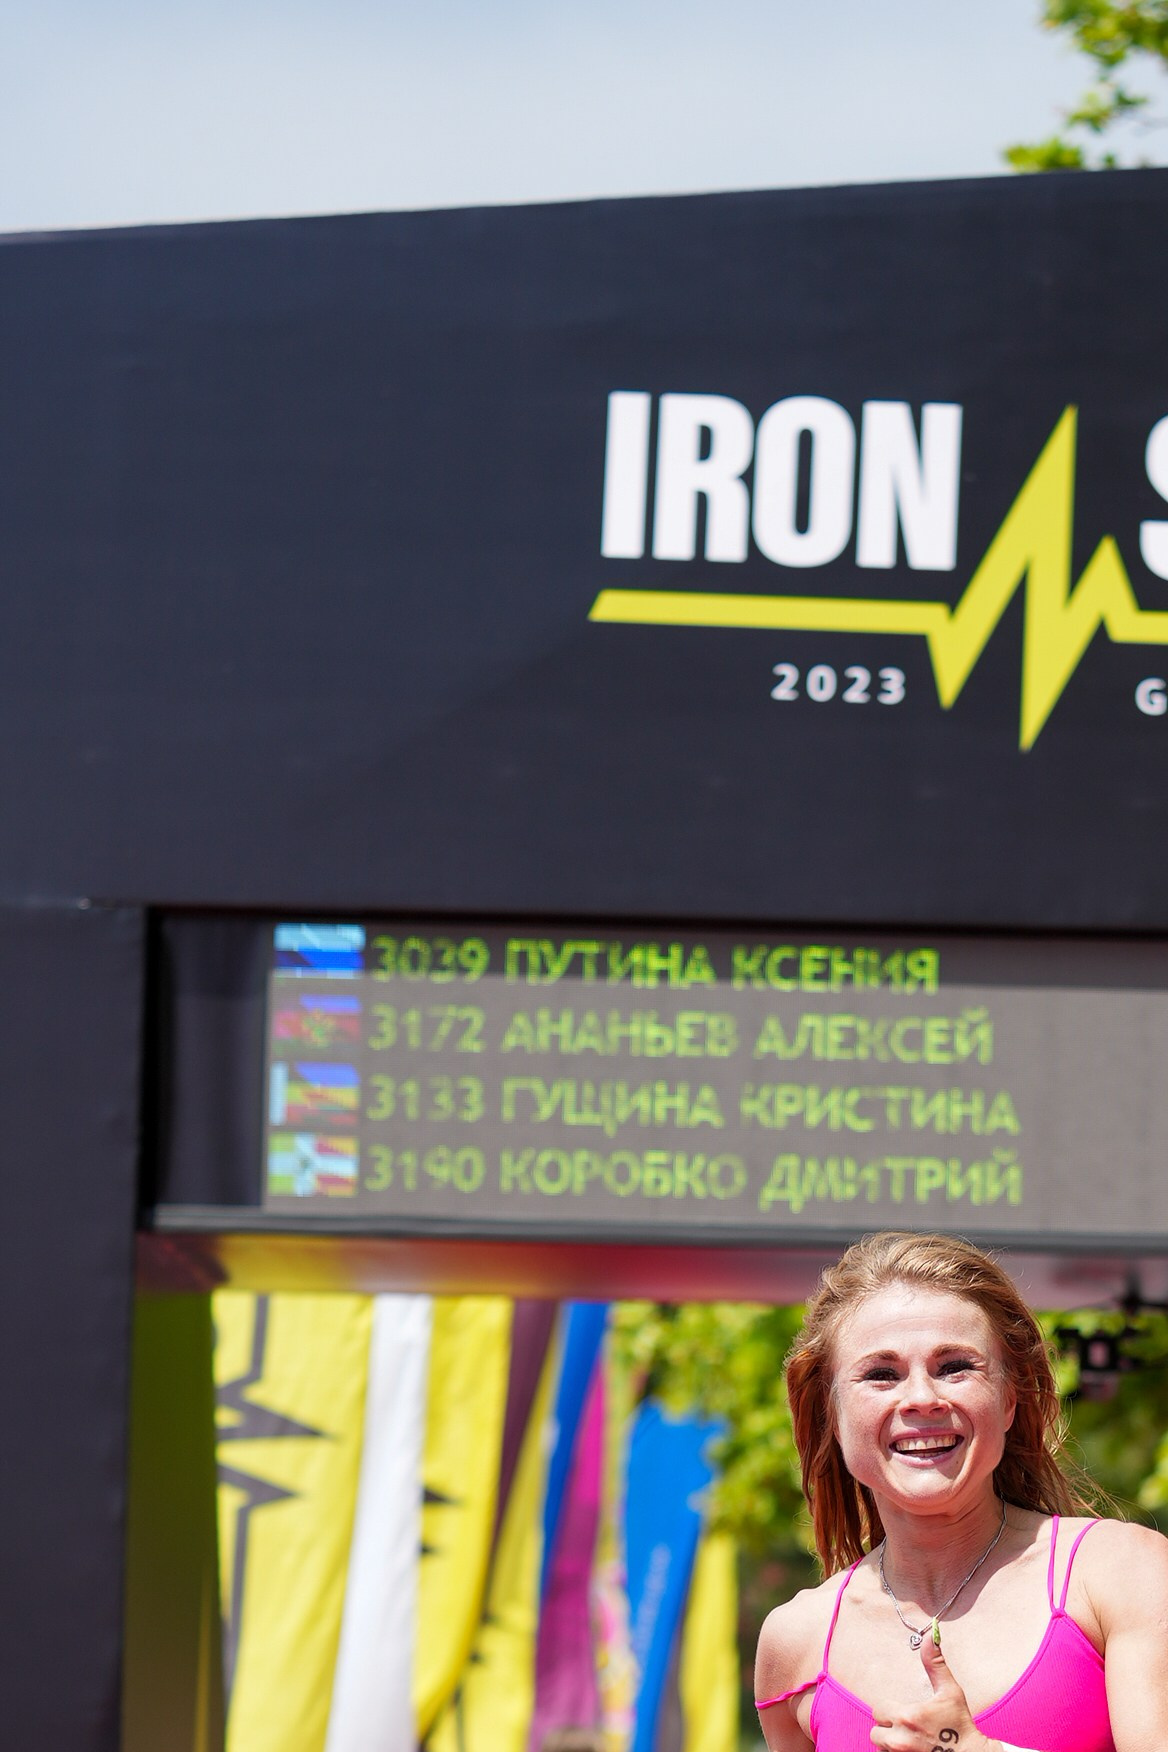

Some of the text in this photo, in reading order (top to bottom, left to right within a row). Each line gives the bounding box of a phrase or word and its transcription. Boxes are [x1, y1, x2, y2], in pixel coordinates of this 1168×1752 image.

[600, 390, 963, 571] IRON
[771, 663, 907, 705] 2023
[367, 935, 941, 996] 3039 ПУТИНА КСЕНИЯ
[367, 1005, 995, 1066] 3172 АНАНЬЕВ АЛЕКСЕЙ
[366, 1074, 1021, 1138] 3133 ГУЩИНА КРИСТИНА
[499, 1149, 747, 1201] КОРОБКО
[759, 1147, 1023, 1214] ДМИТРИЙ
